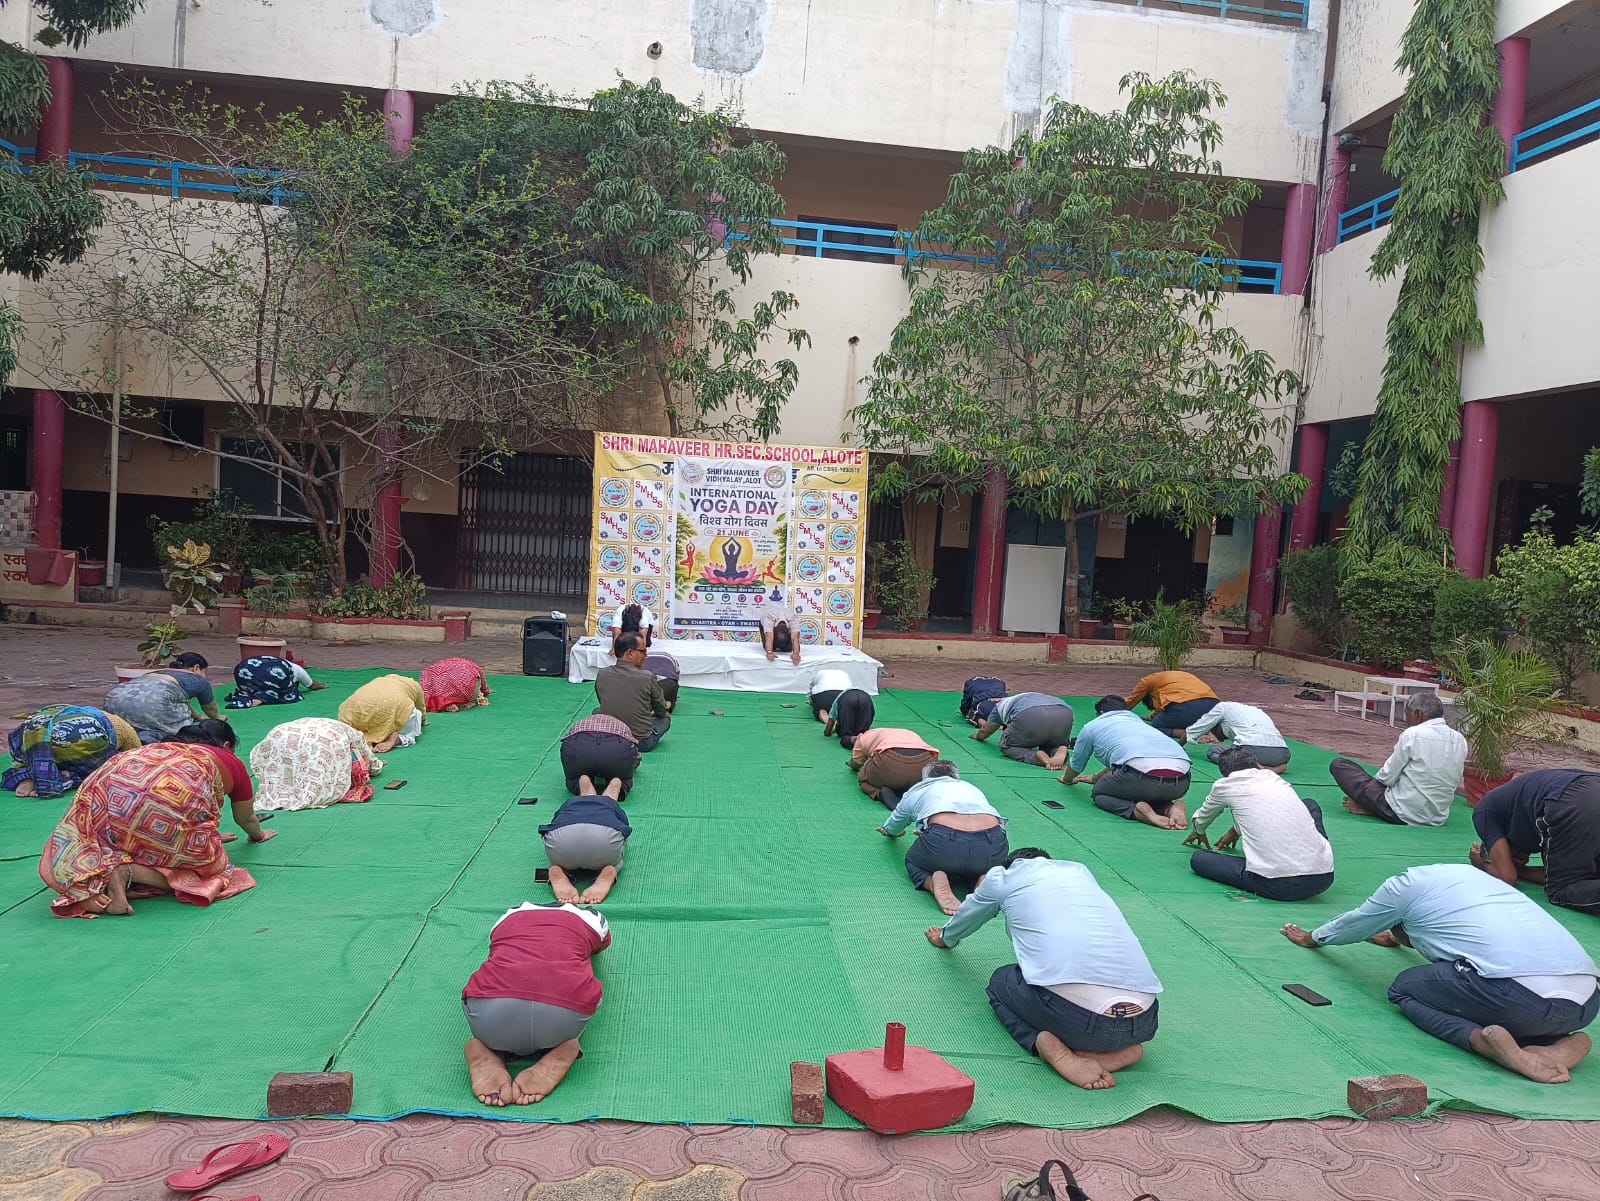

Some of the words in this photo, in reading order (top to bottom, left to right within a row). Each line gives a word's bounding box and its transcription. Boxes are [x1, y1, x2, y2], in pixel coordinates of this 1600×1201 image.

[602, 436, 634, 451] SHRI
[638, 437, 710, 457] MAHAVEER
[706, 467, 722, 475] SHRI
[723, 468, 760, 477] MAHAVEER
[690, 487, 777, 500] INTERNATIONAL
[689, 498, 741, 514] YOGA
[745, 500, 779, 516] DAY
[699, 514, 722, 526] विश्व
[723, 515, 743, 526] योग
[744, 515, 769, 528] दिवस
[727, 529, 750, 537] JUNE
